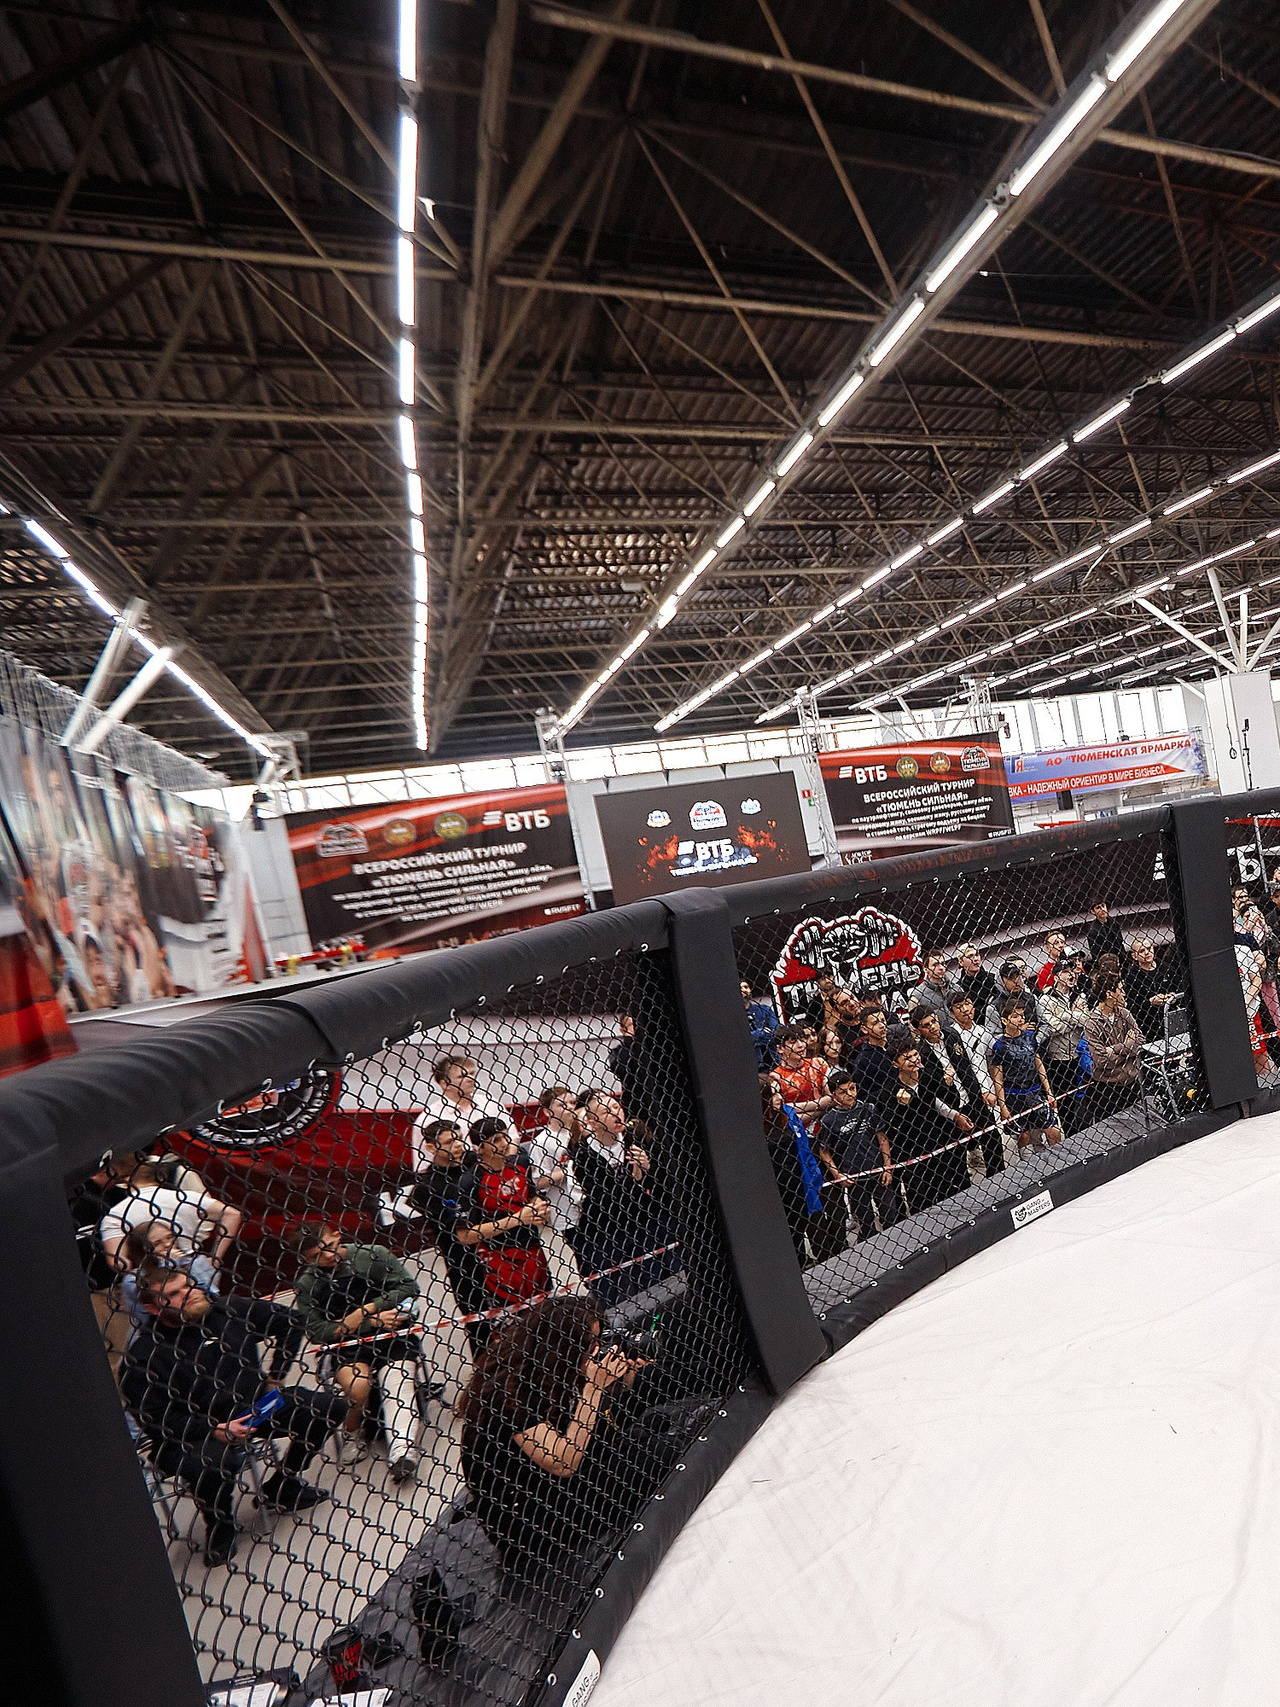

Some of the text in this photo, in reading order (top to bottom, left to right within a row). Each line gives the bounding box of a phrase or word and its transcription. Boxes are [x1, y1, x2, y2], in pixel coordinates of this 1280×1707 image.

[1046, 757, 1062, 767] АО
[854, 764, 887, 784] ВТБ
[1027, 779, 1070, 795] НАДЕЖНЫЙ
[1070, 774, 1107, 788] ОРИЕНТИР
[1108, 773, 1114, 782] В
[1114, 769, 1134, 781] МИРЕ
[1134, 765, 1165, 779] БИЗНЕСА
[863, 778, 975, 804] ВСЕРОССИЙСКИЙ ТУРНИР
[876, 791, 969, 814] «ТЮМЕНЬ СИЛЬНАЯ»
[505, 810, 551, 832] ВТБ
[352, 842, 528, 875] ВСЕРОССИЙСКИЙ ТУРНИР
[695, 838, 734, 860] ВТБ
[371, 860, 517, 888] «ТЮМЕНЬ СИЛЬНАЯ»
